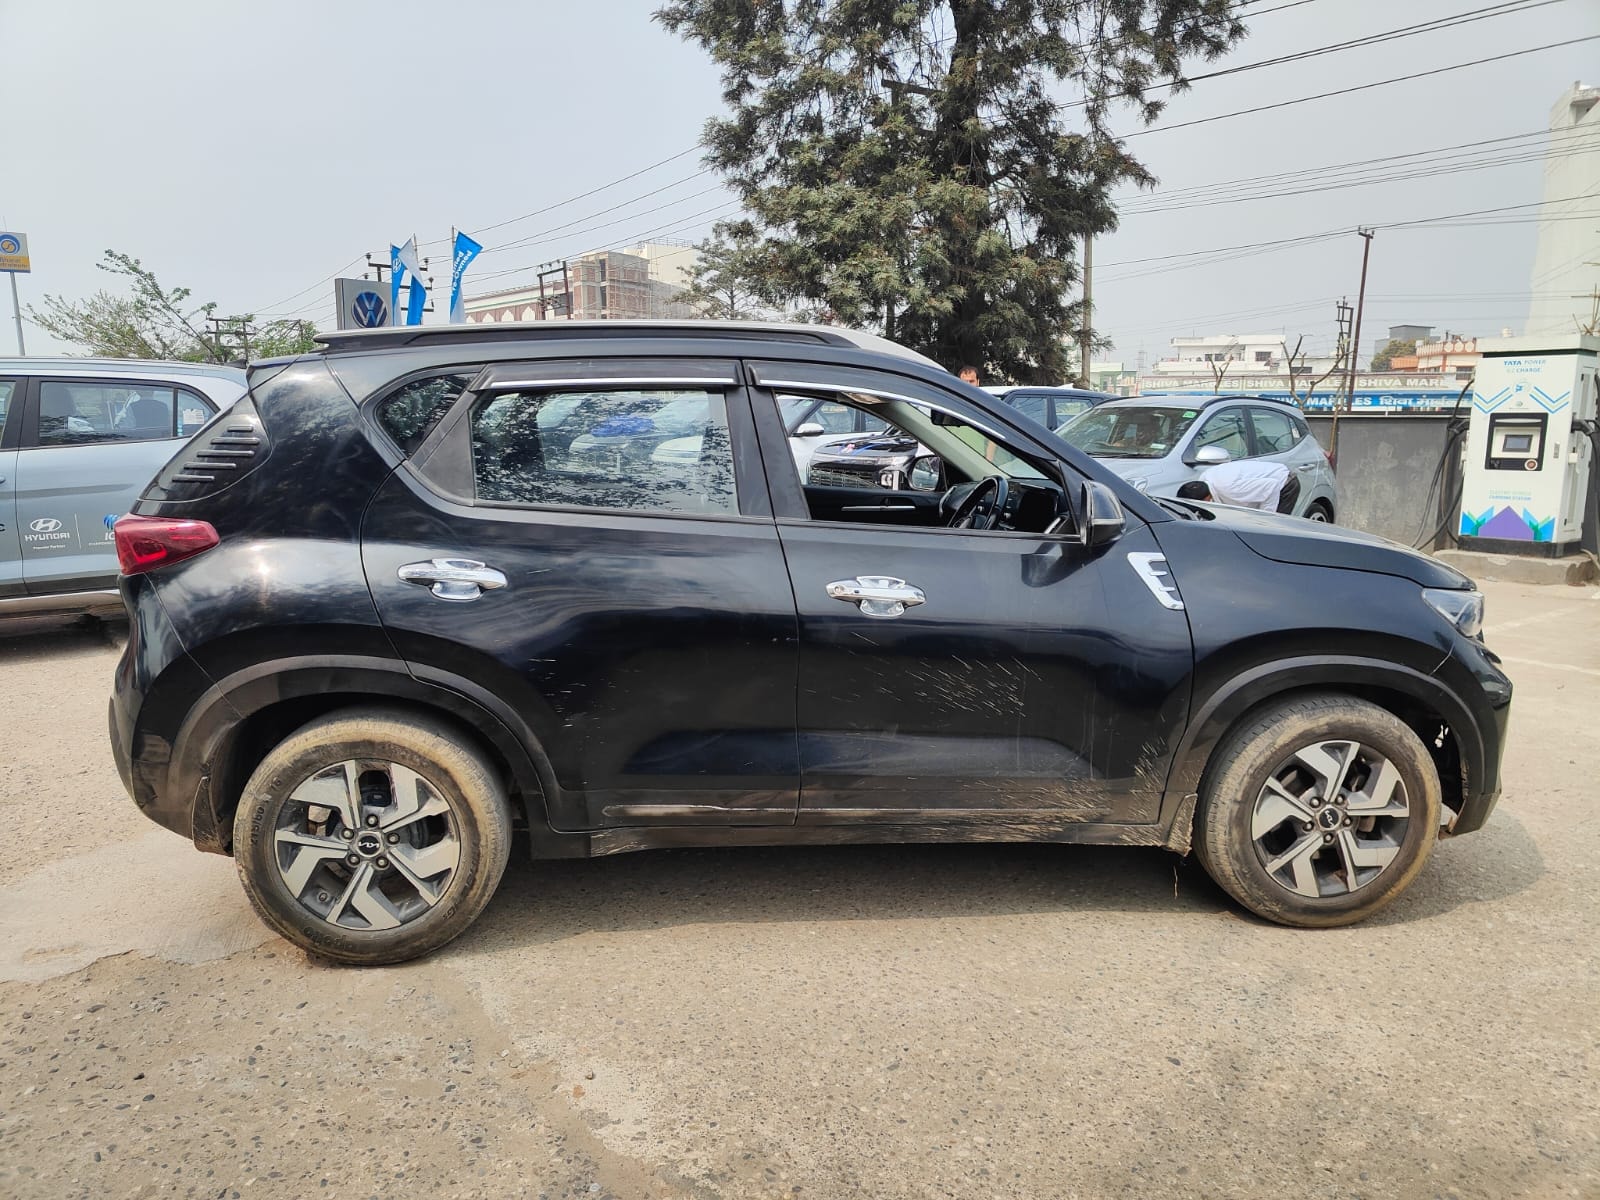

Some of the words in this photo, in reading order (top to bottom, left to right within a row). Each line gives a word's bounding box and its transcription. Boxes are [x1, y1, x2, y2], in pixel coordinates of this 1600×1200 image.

[1144, 379, 1180, 389] SHIVA
[1247, 379, 1285, 388] SHIVA
[1359, 378, 1402, 387] SHIVA
[24, 532, 70, 542] HYUNDAI
